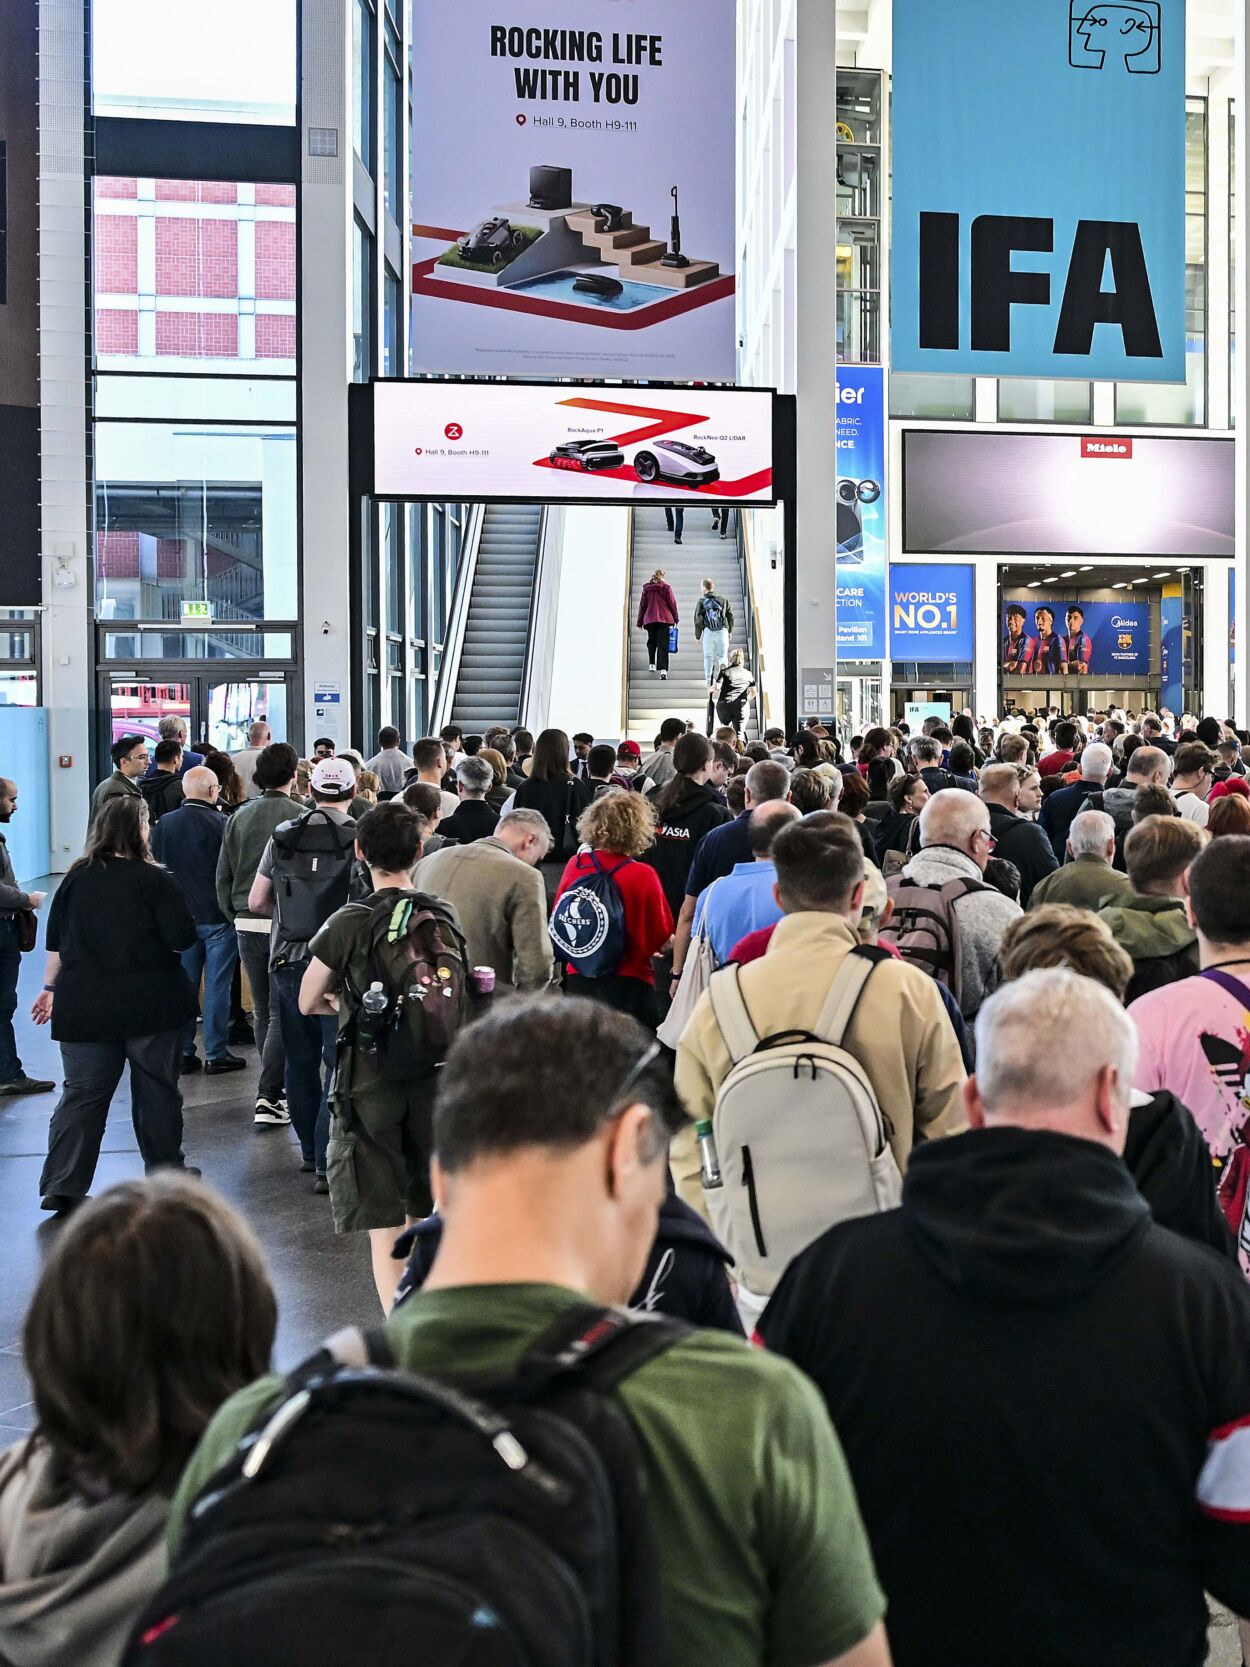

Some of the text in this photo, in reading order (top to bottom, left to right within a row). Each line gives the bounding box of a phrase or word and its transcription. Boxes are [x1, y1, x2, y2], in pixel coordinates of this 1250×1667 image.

[490, 25, 662, 66] ROCKING LIFE
[514, 67, 639, 105] WITH YOU
[533, 116, 637, 131] Hall 9, Booth H9-111
[919, 211, 1163, 358] IFA
[835, 382, 865, 404] ier
[836, 417, 862, 425] ABRIC.
[1086, 443, 1127, 453] Miele
[837, 587, 864, 597] CARE
[894, 592, 957, 603] WORLD'S
[836, 598, 862, 607] CTION
[894, 604, 957, 629] NO.1
[1111, 615, 1138, 628] Midea
[665, 826, 690, 838] AStA
